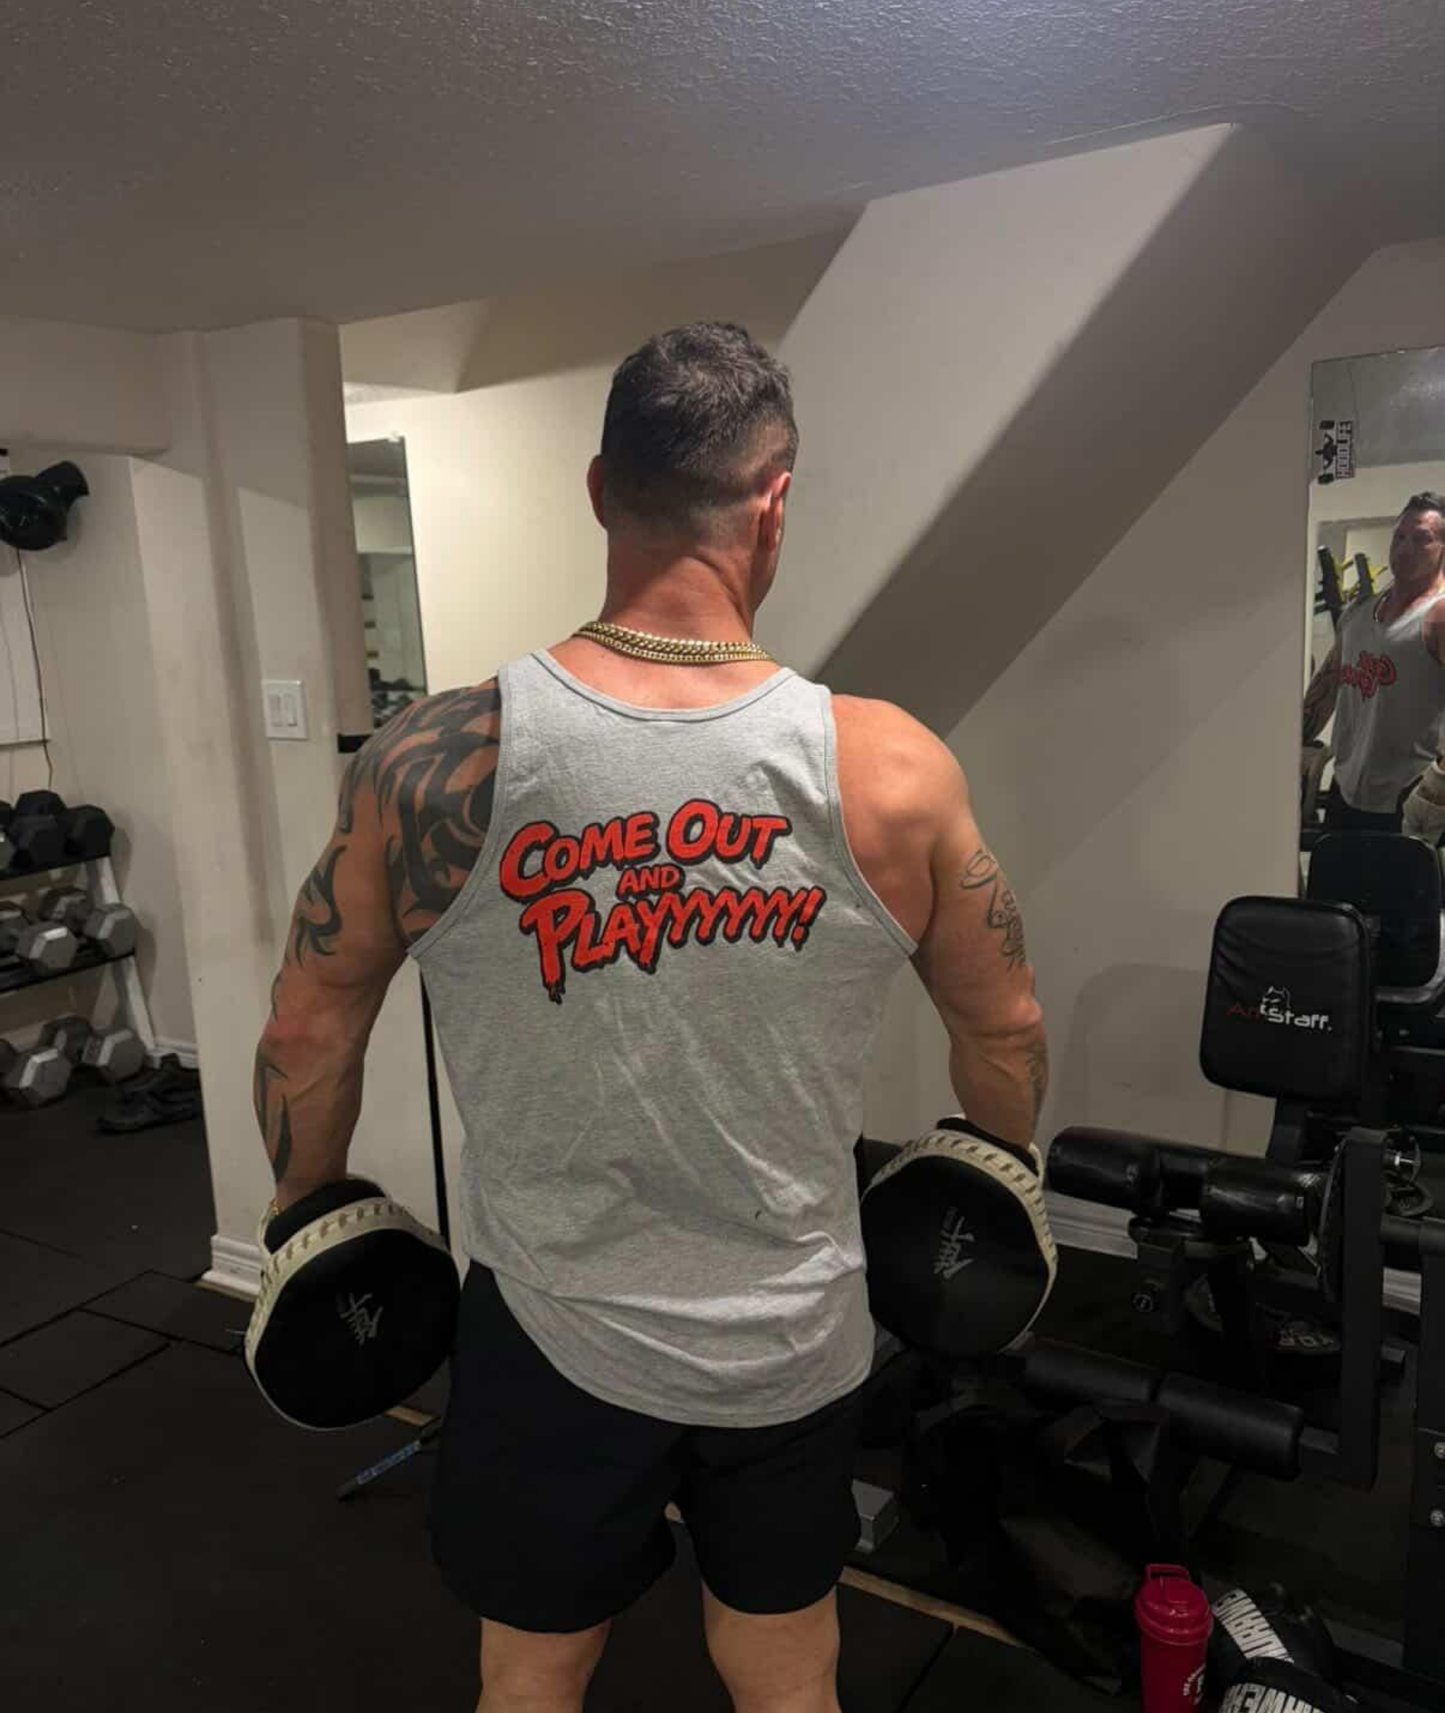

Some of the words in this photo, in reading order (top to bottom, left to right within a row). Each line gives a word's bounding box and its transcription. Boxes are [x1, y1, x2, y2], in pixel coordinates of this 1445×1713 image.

[500, 811, 659, 904] COME
[665, 798, 792, 869] OUT
[616, 862, 686, 901] AND
